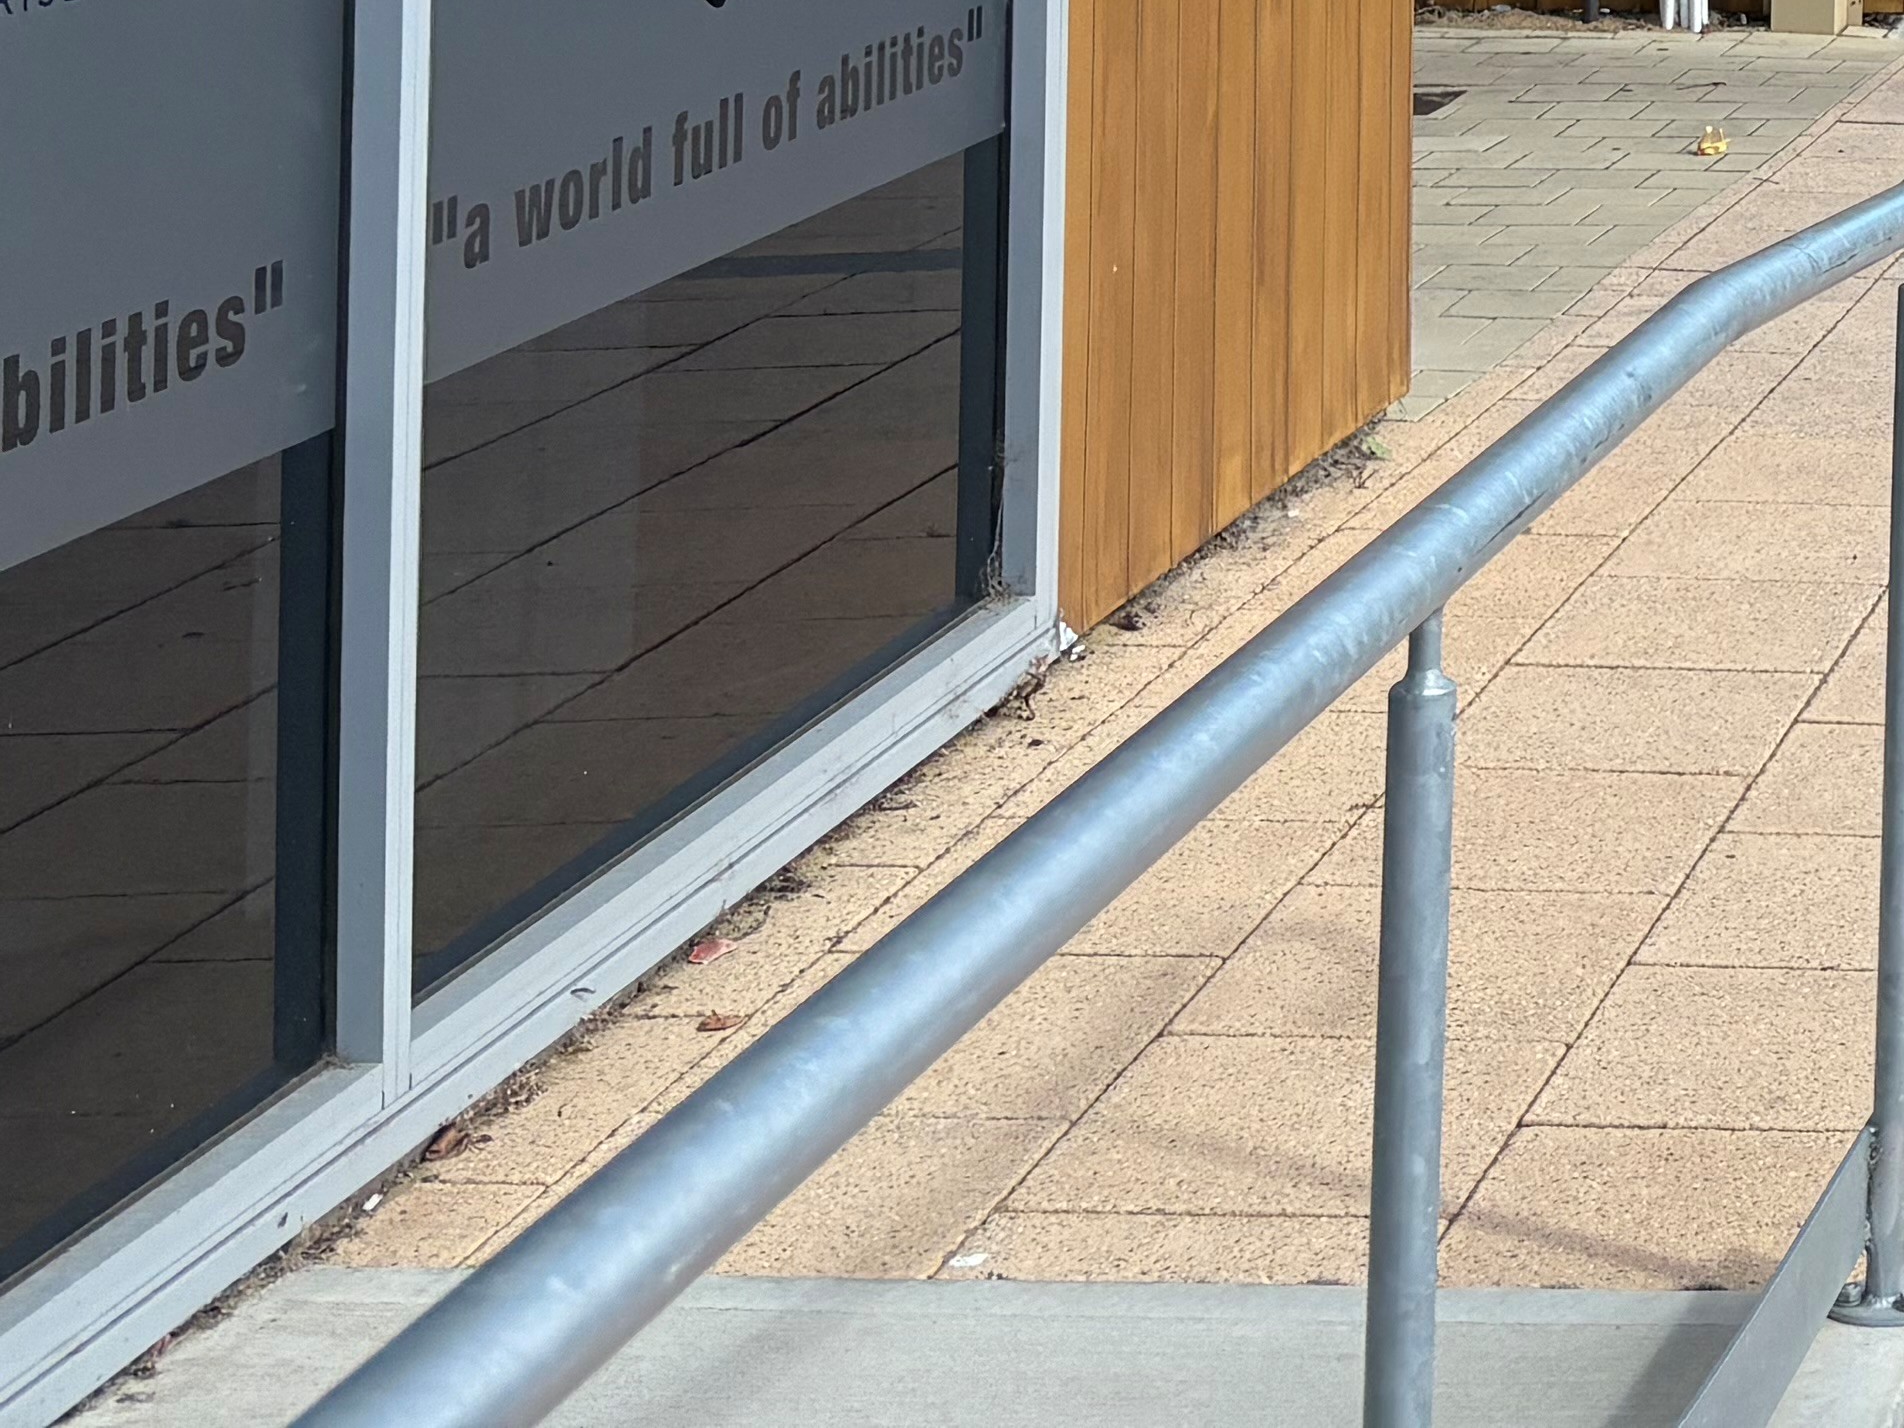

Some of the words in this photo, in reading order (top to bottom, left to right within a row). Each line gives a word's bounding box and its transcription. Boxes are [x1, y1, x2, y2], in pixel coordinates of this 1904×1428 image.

[513, 125, 653, 248] world
[671, 91, 744, 187] full
[762, 69, 801, 151] of
